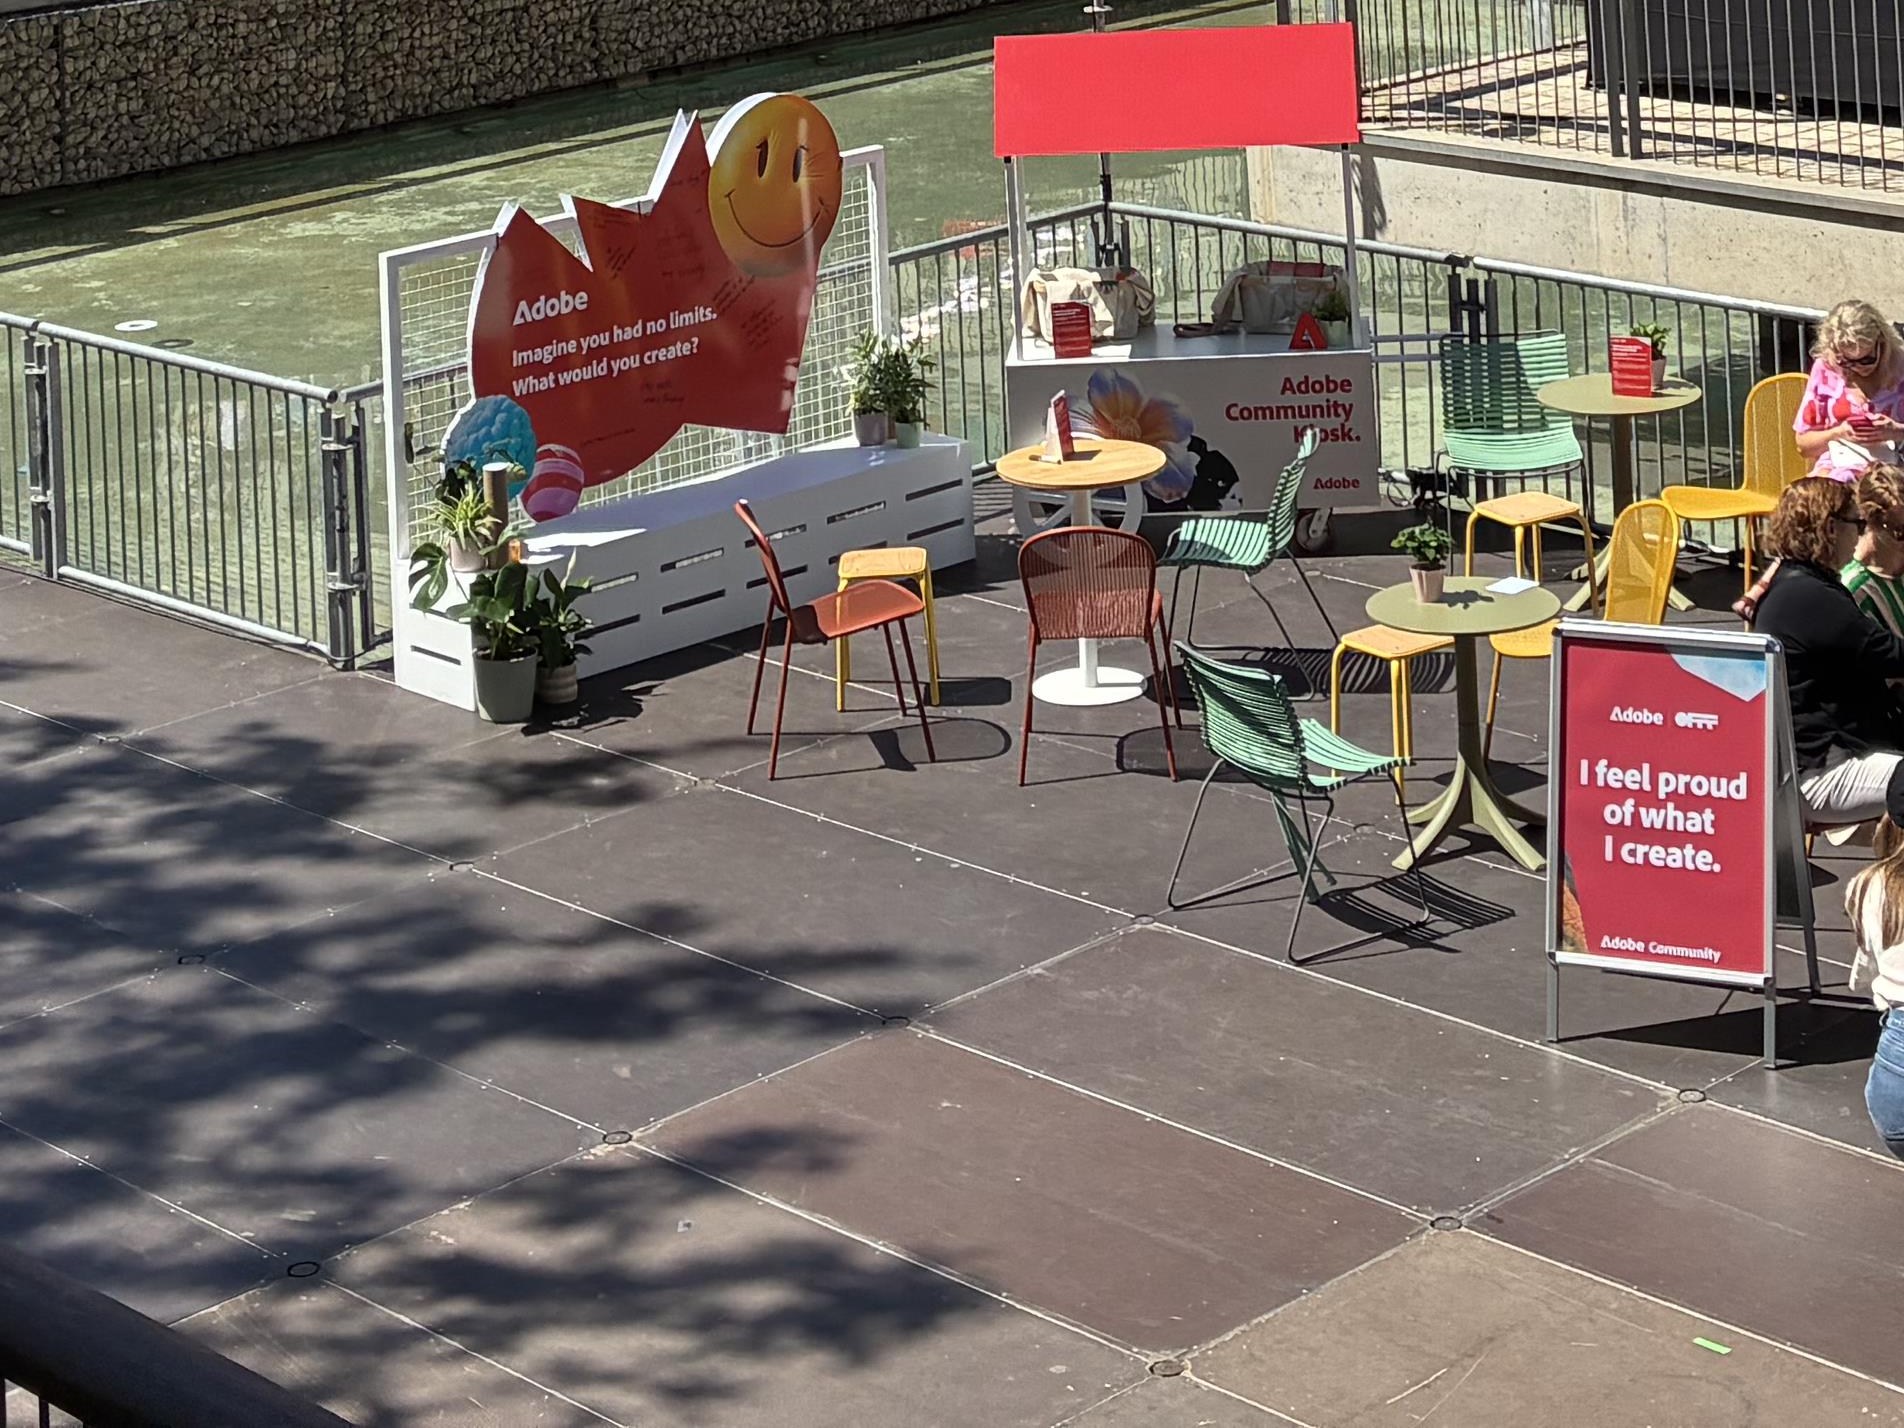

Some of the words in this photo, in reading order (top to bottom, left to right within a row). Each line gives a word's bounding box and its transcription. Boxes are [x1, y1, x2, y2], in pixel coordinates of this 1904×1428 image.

[512, 289, 589, 326] Adobe
[512, 339, 578, 368] Imagine
[579, 333, 611, 356] you
[612, 320, 644, 344] had
[646, 316, 667, 336] no
[669, 305, 719, 330] limits.
[512, 370, 556, 398] What
[558, 359, 609, 386] would
[610, 353, 641, 378] you
[642, 336, 700, 366] create?
[1279, 374, 1353, 395] Adobe
[1224, 398, 1354, 423] Community
[1312, 477, 1361, 491] Adobe
[1609, 705, 1664, 726] Adobe
[1579, 759, 1589, 786] I
[1595, 758, 1651, 792] feel
[1658, 770, 1748, 801] proud
[1603, 798, 1635, 827] of
[1639, 802, 1716, 836] what
[1604, 834, 1614, 862] I
[1620, 841, 1722, 874] create.
[1600, 934, 1645, 953] Adobe
[1648, 941, 1722, 964] Community
